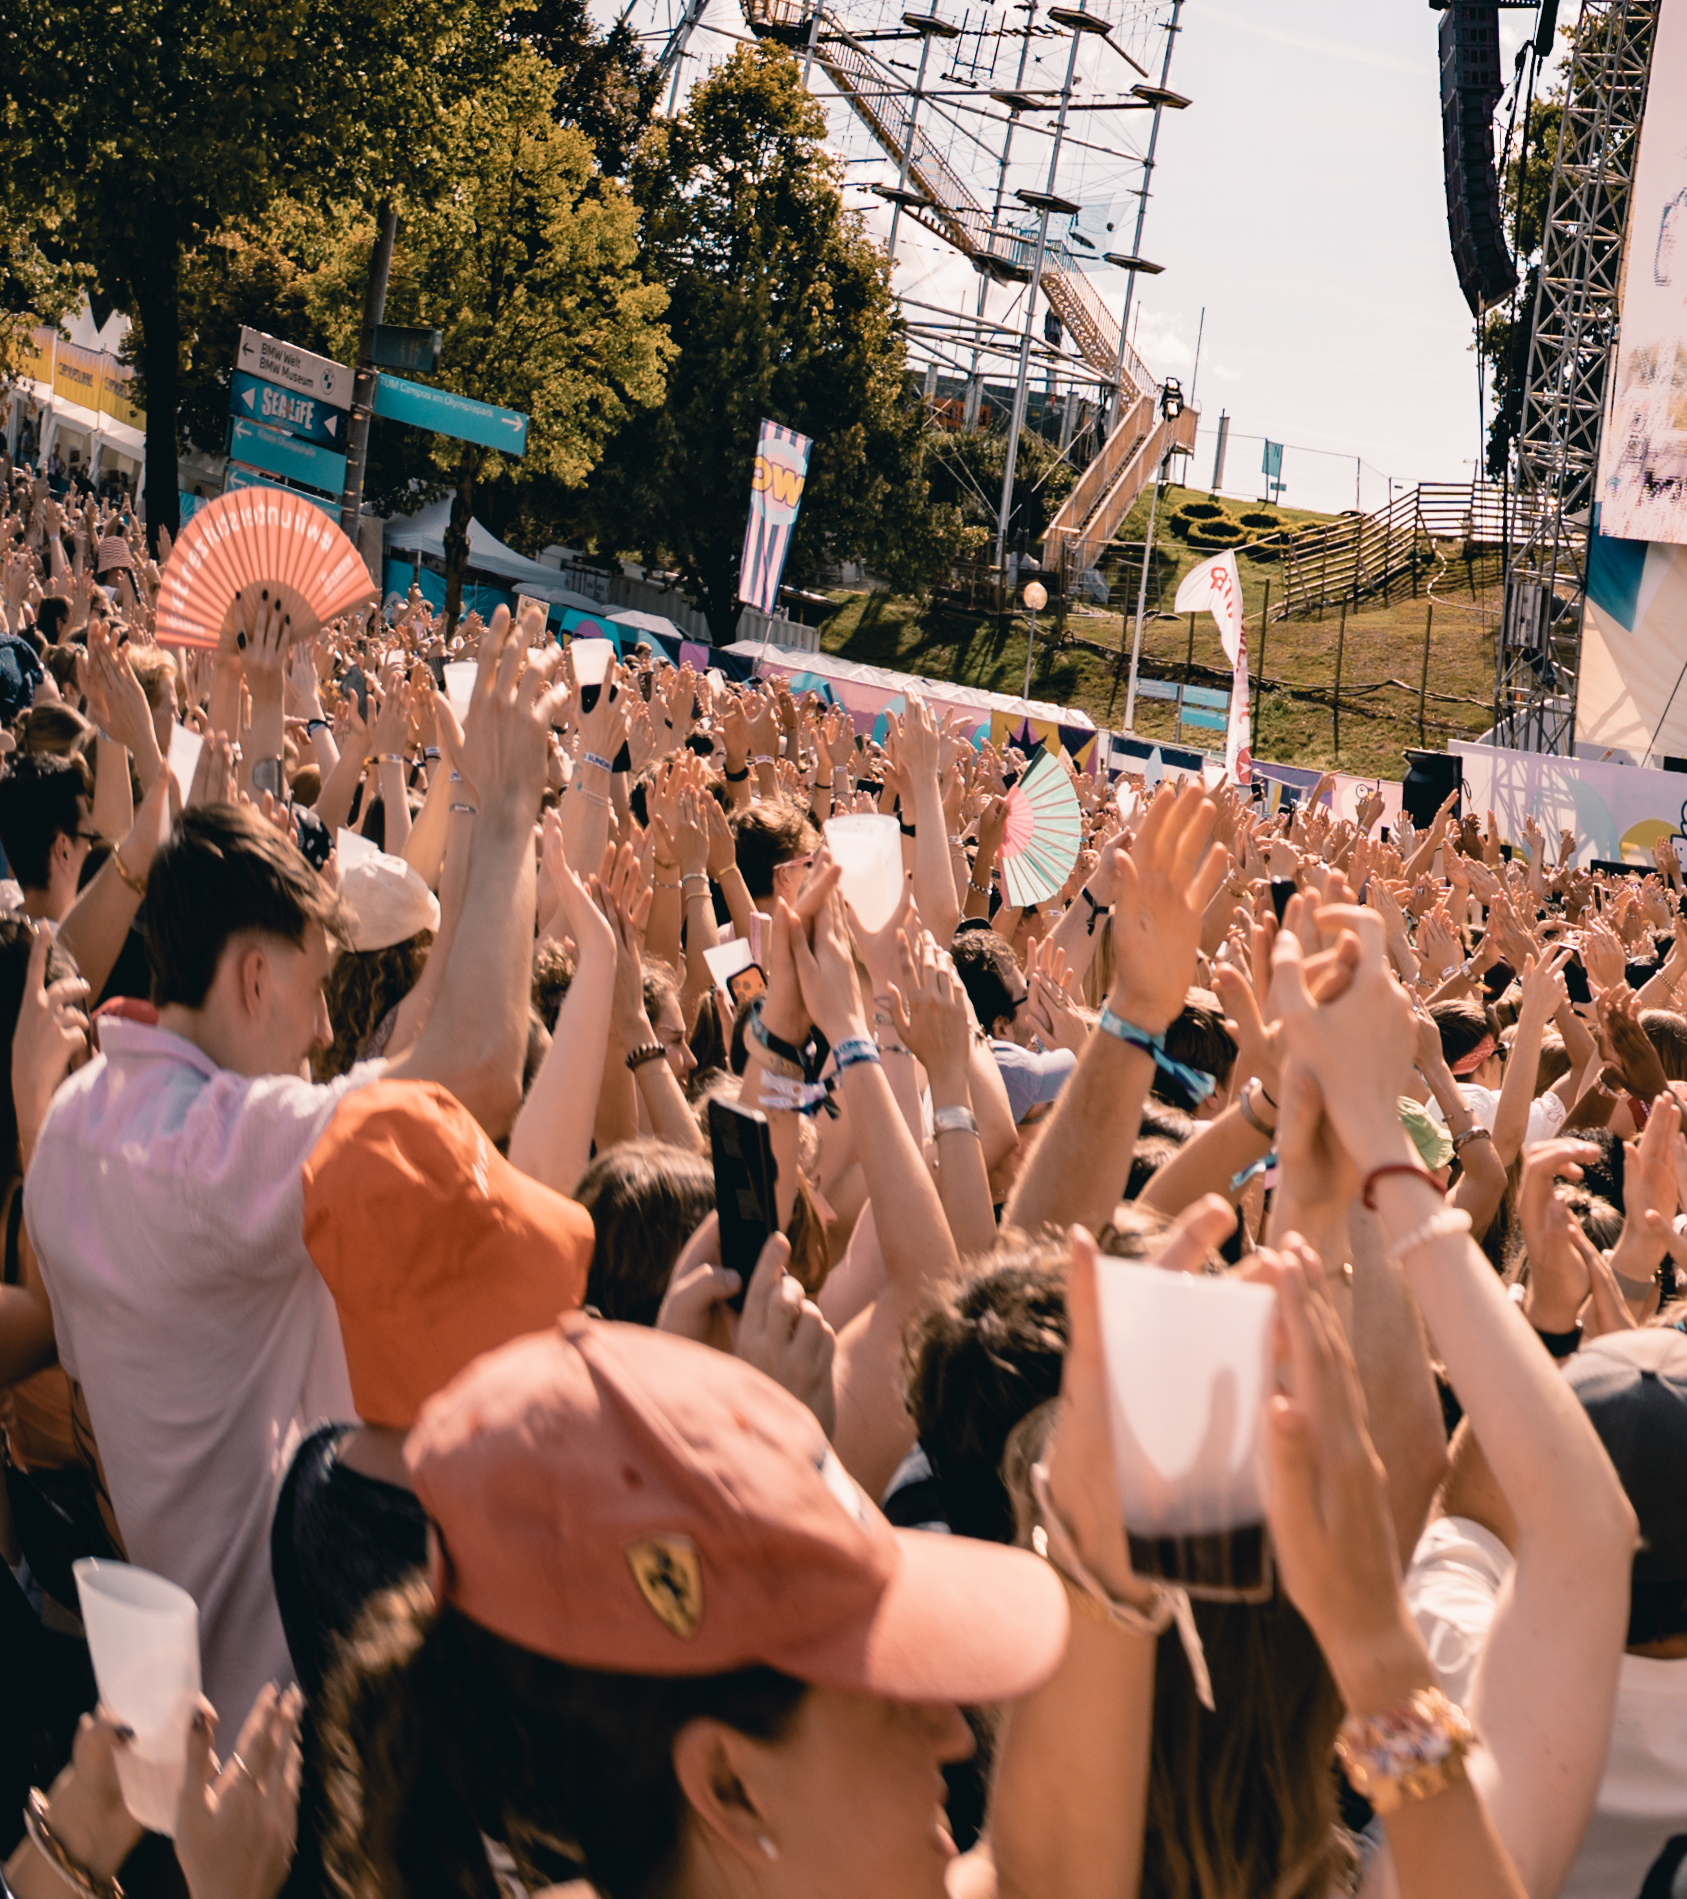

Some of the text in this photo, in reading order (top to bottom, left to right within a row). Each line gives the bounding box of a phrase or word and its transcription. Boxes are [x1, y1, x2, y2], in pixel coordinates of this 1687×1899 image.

[261, 343, 282, 361] BMW
[260, 357, 279, 375] BMW
[261, 387, 287, 419] SEA
